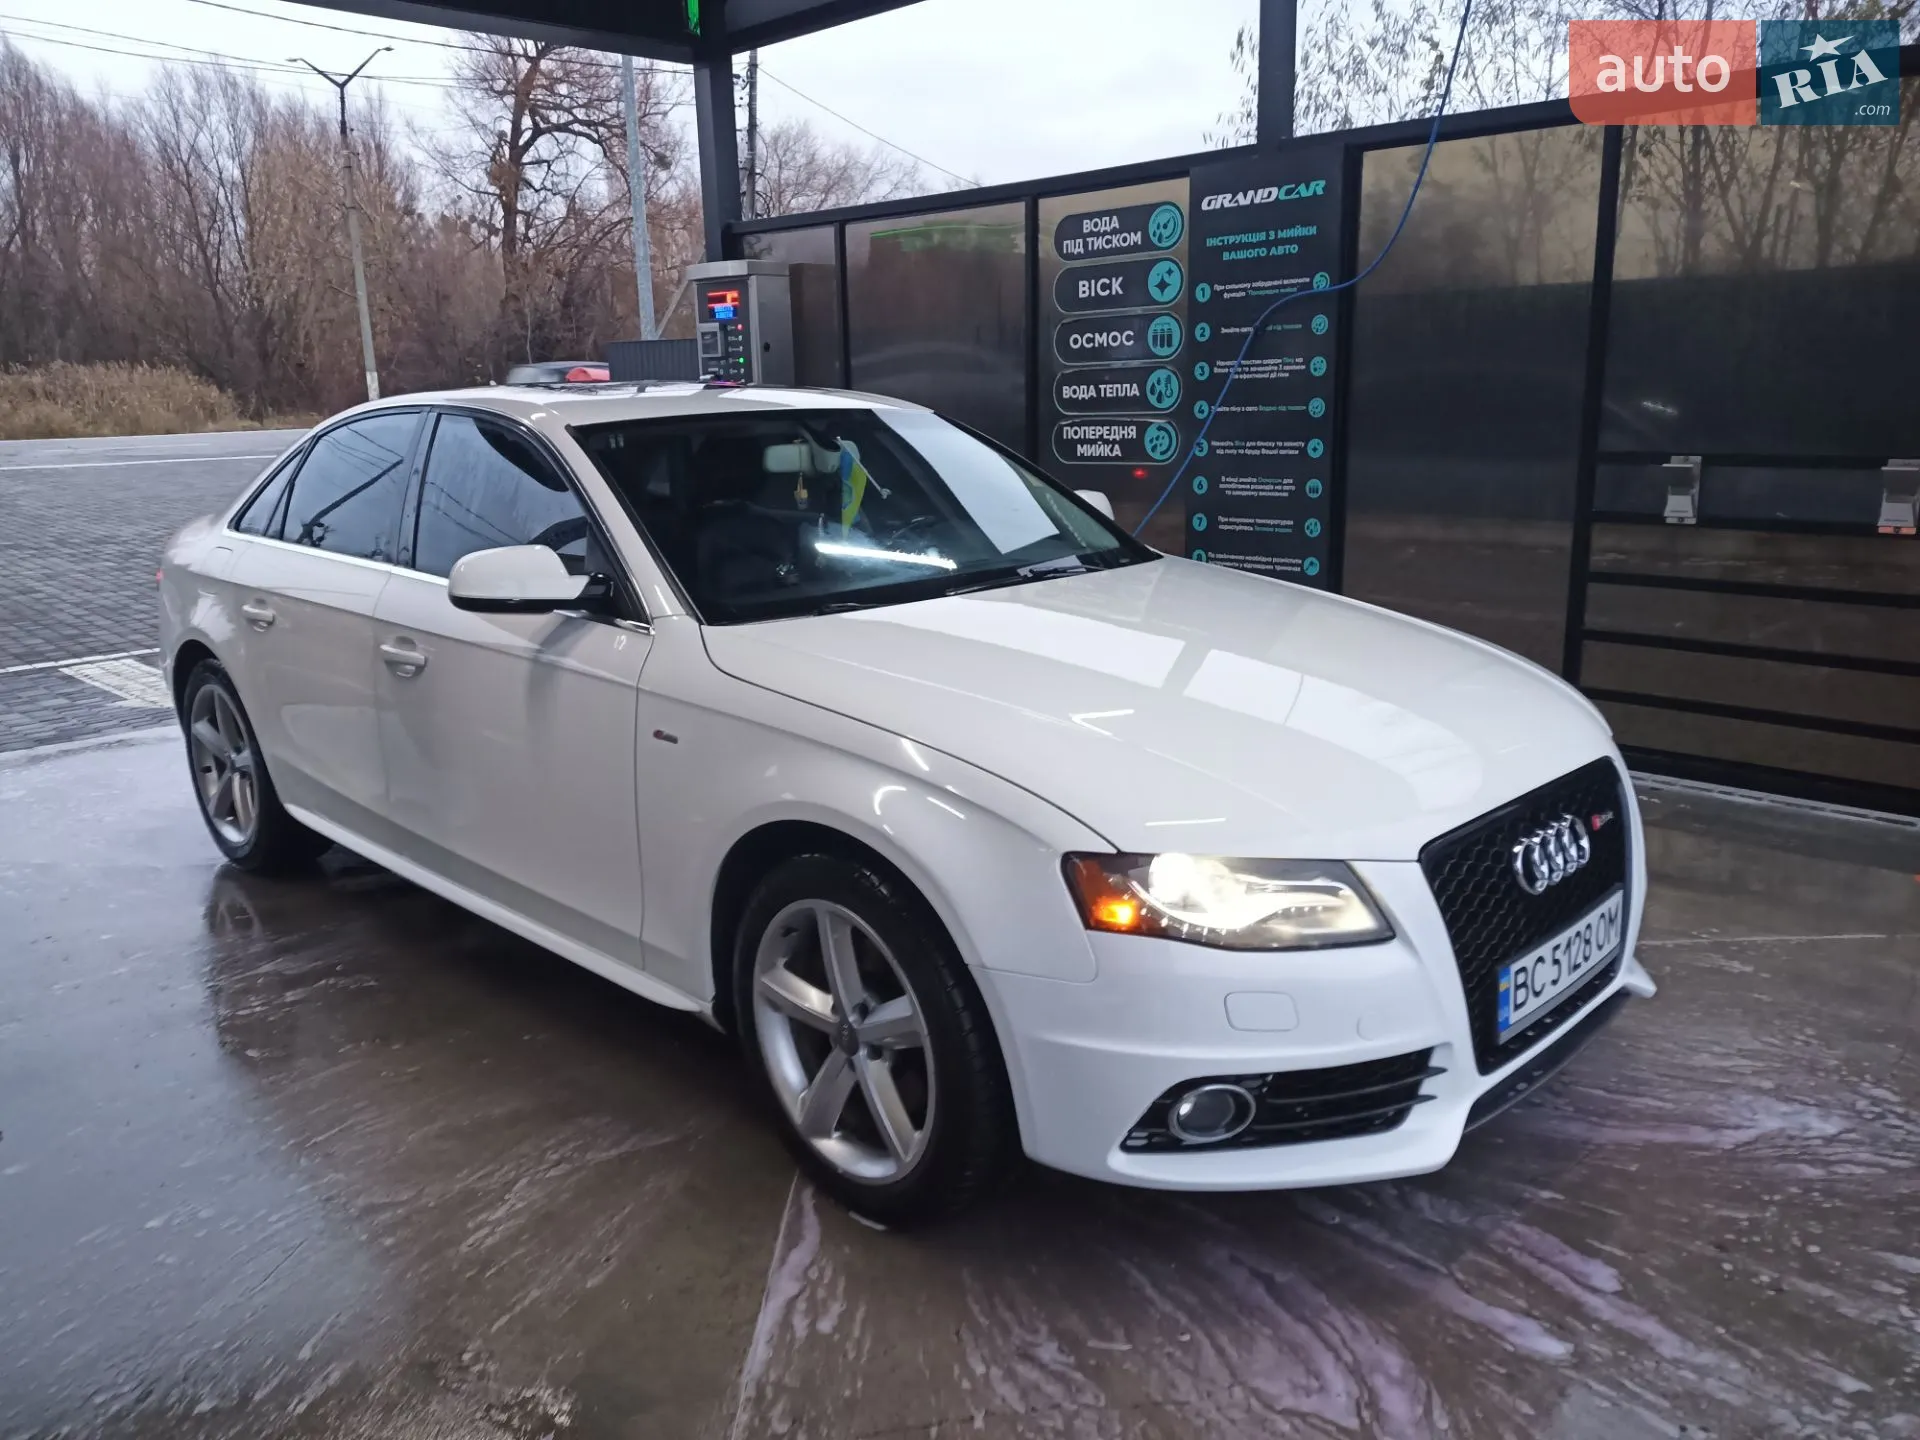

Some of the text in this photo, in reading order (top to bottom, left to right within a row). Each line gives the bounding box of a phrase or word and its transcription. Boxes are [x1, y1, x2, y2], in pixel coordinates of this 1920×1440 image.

[1082, 216, 1120, 233] ВОДА
[1063, 231, 1142, 255] ПІД ТИСКОМ
[1206, 231, 1267, 248] ІНСТРУКЦІЯ
[1277, 224, 1318, 240] МИЙКИ
[1223, 244, 1299, 261] ВАШОГО АВТО
[1078, 276, 1124, 298] ВІСК
[1069, 330, 1135, 349] ОСМОС
[1062, 383, 1140, 401] ВОДА ТЕПЛА
[1063, 425, 1137, 441] ПОПЕРЕДНЯ
[1076, 441, 1122, 457] МИЙКА
[1513, 901, 1620, 1012] BC 5128 OM
